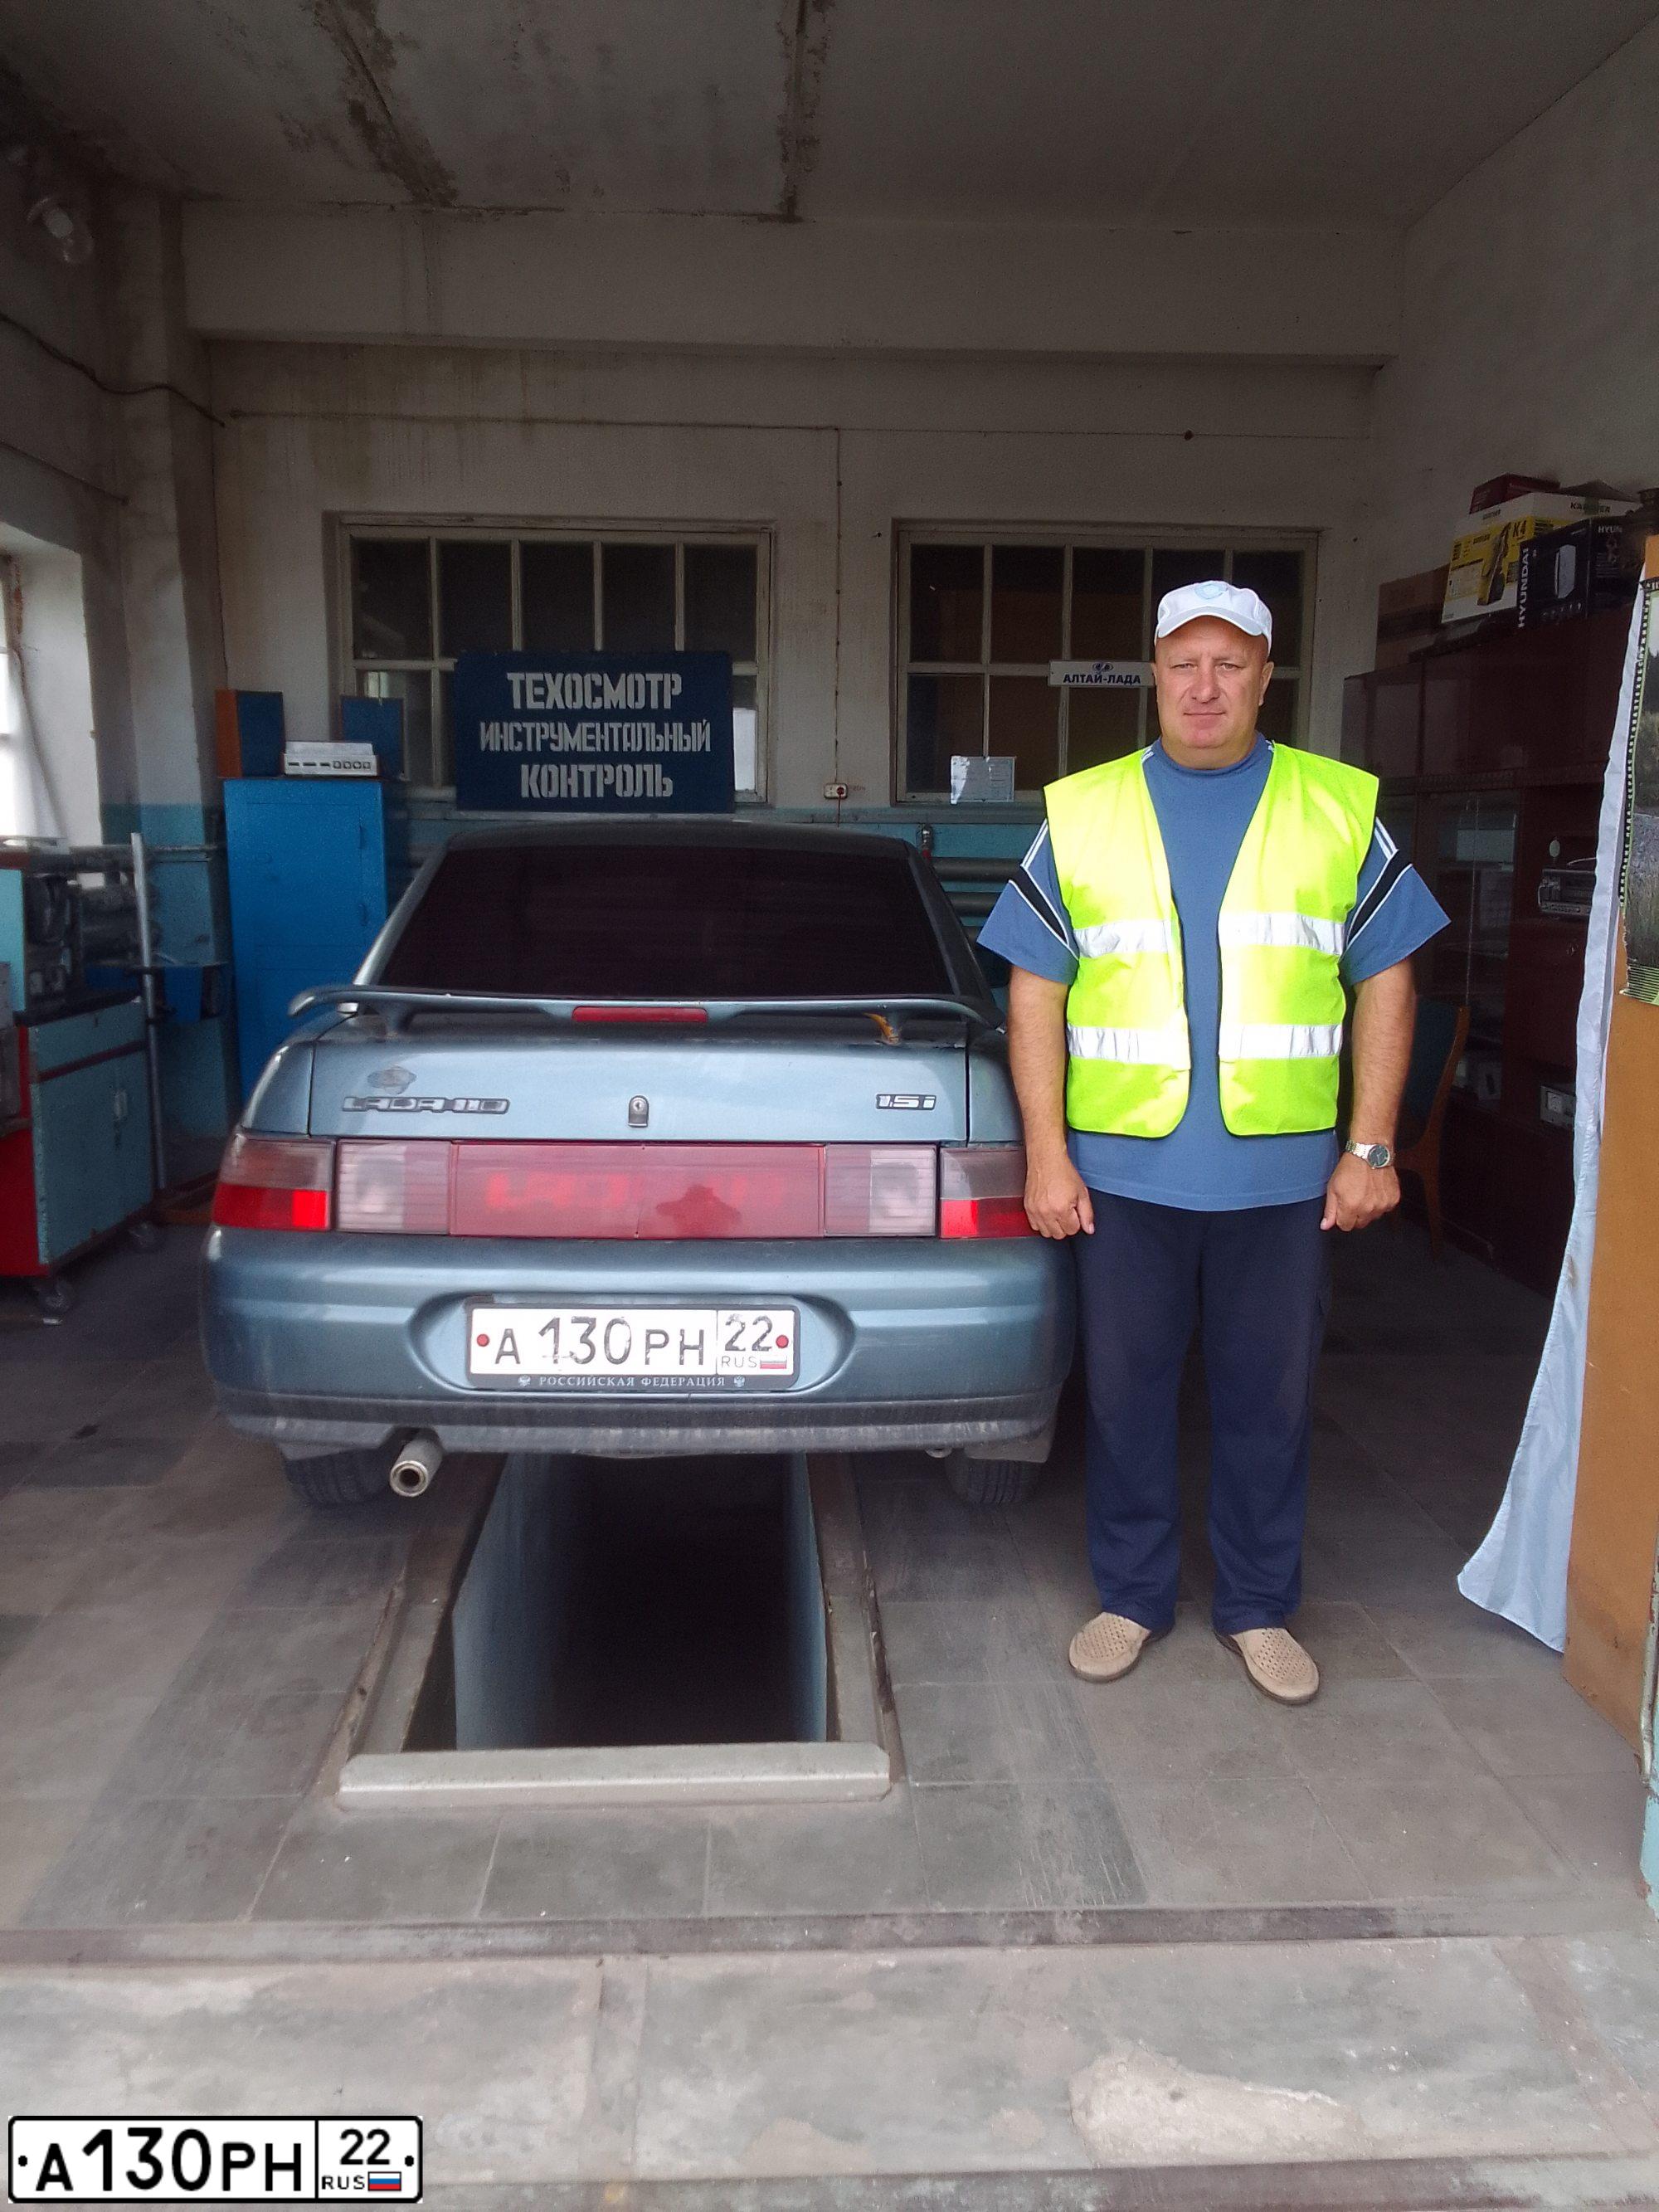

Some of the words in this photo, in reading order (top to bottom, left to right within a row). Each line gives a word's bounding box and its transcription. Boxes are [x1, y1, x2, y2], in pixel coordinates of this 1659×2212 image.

[1517, 548, 1529, 628] HYUNDAI
[507, 672, 683, 709] ТЕХОСМОТР
[1063, 672, 1141, 685] АЛТАЙ-ЛАДА
[479, 719, 711, 752] ИНСТРУМЕНТАЛЬНЫЙ
[521, 764, 673, 798] КОНТРОЛЬ
[343, 1097, 446, 1112] LADA
[453, 1098, 510, 1114] 110
[725, 1314, 774, 1352] 22
[721, 1356, 757, 1369] RUS
[539, 1376, 635, 1386] РОССИЙСКАЯ
[641, 1376, 725, 1387] ФЕДЕРАЦИЯ
